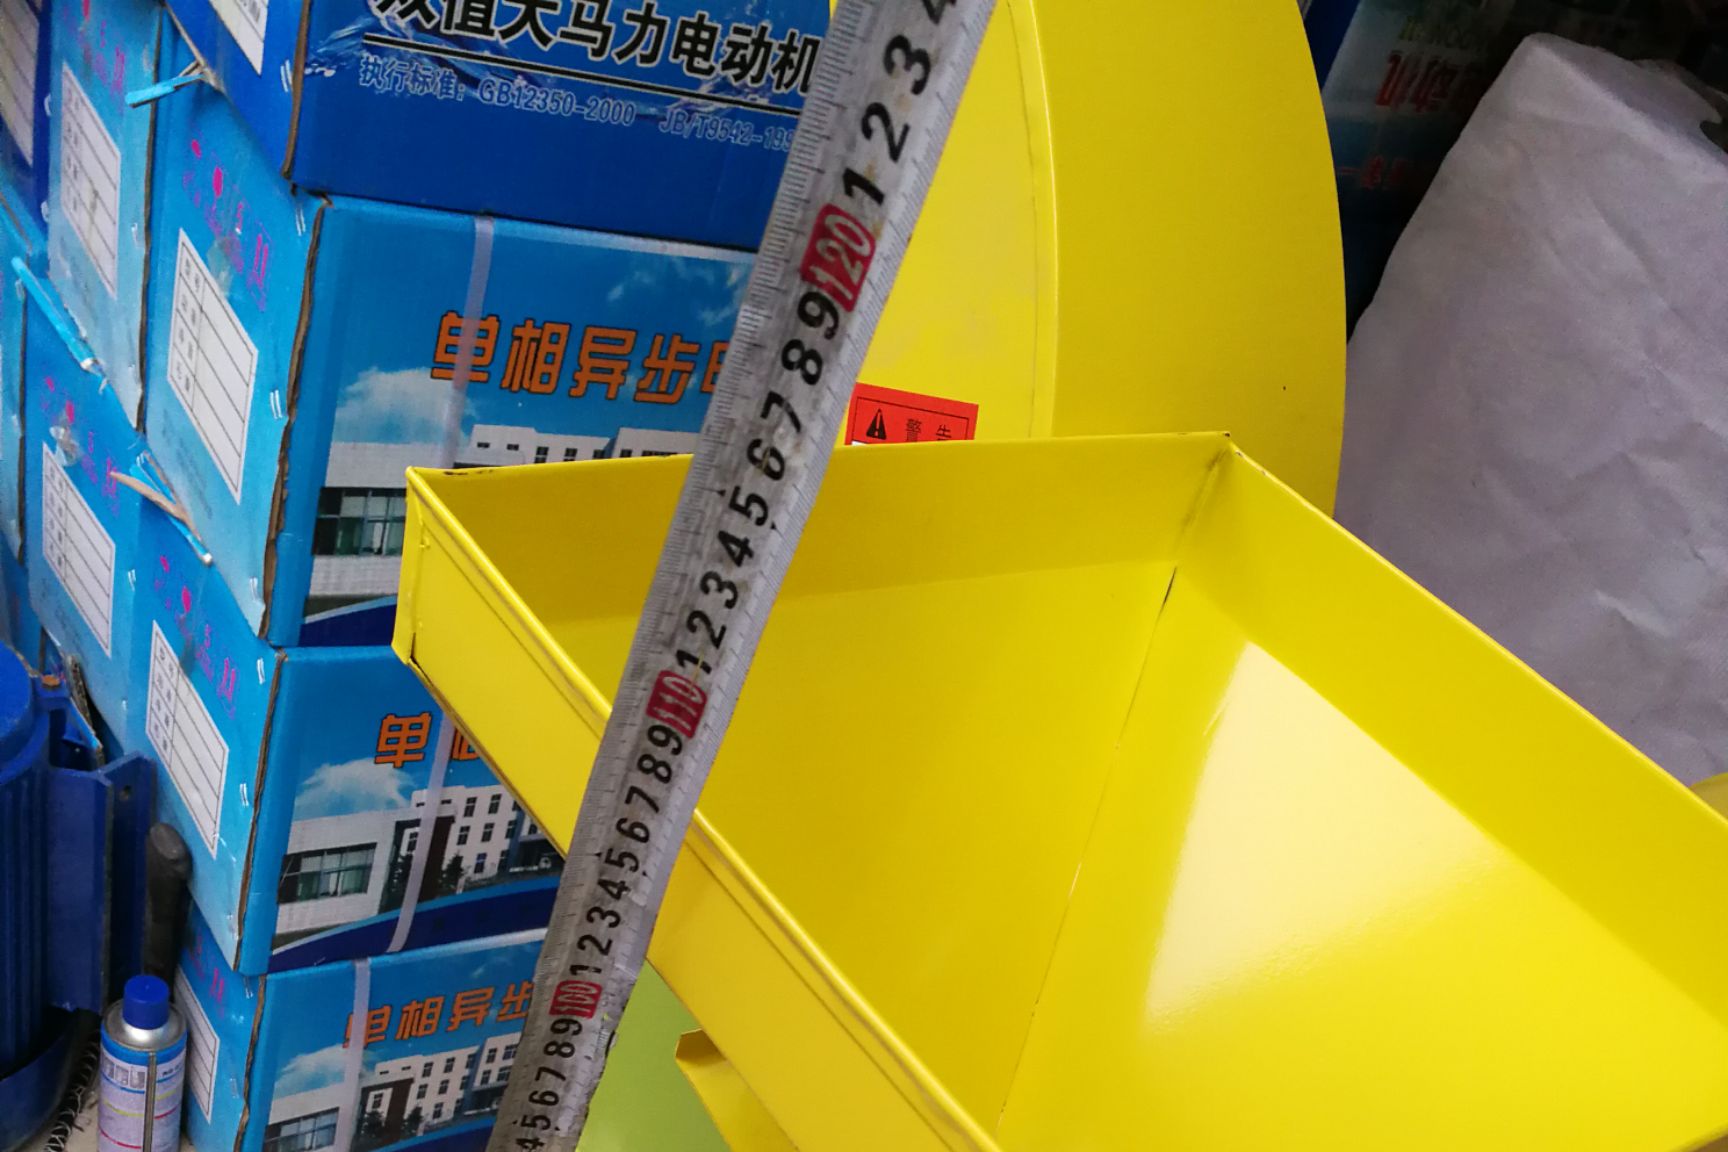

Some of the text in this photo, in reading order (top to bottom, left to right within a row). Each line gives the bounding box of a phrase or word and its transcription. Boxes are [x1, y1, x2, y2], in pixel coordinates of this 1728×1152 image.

[882, 34, 933, 96] 3
[860, 101, 911, 164] 2
[842, 167, 886, 206] 1
[808, 211, 872, 304] 120
[797, 291, 840, 340] 9
[781, 339, 824, 386] 8
[760, 390, 803, 435] 7
[747, 438, 786, 482] 6
[728, 485, 770, 527] 5
[717, 530, 755, 568] 4
[699, 571, 740, 610] 3
[685, 609, 727, 651] 2
[674, 648, 713, 675] 1
